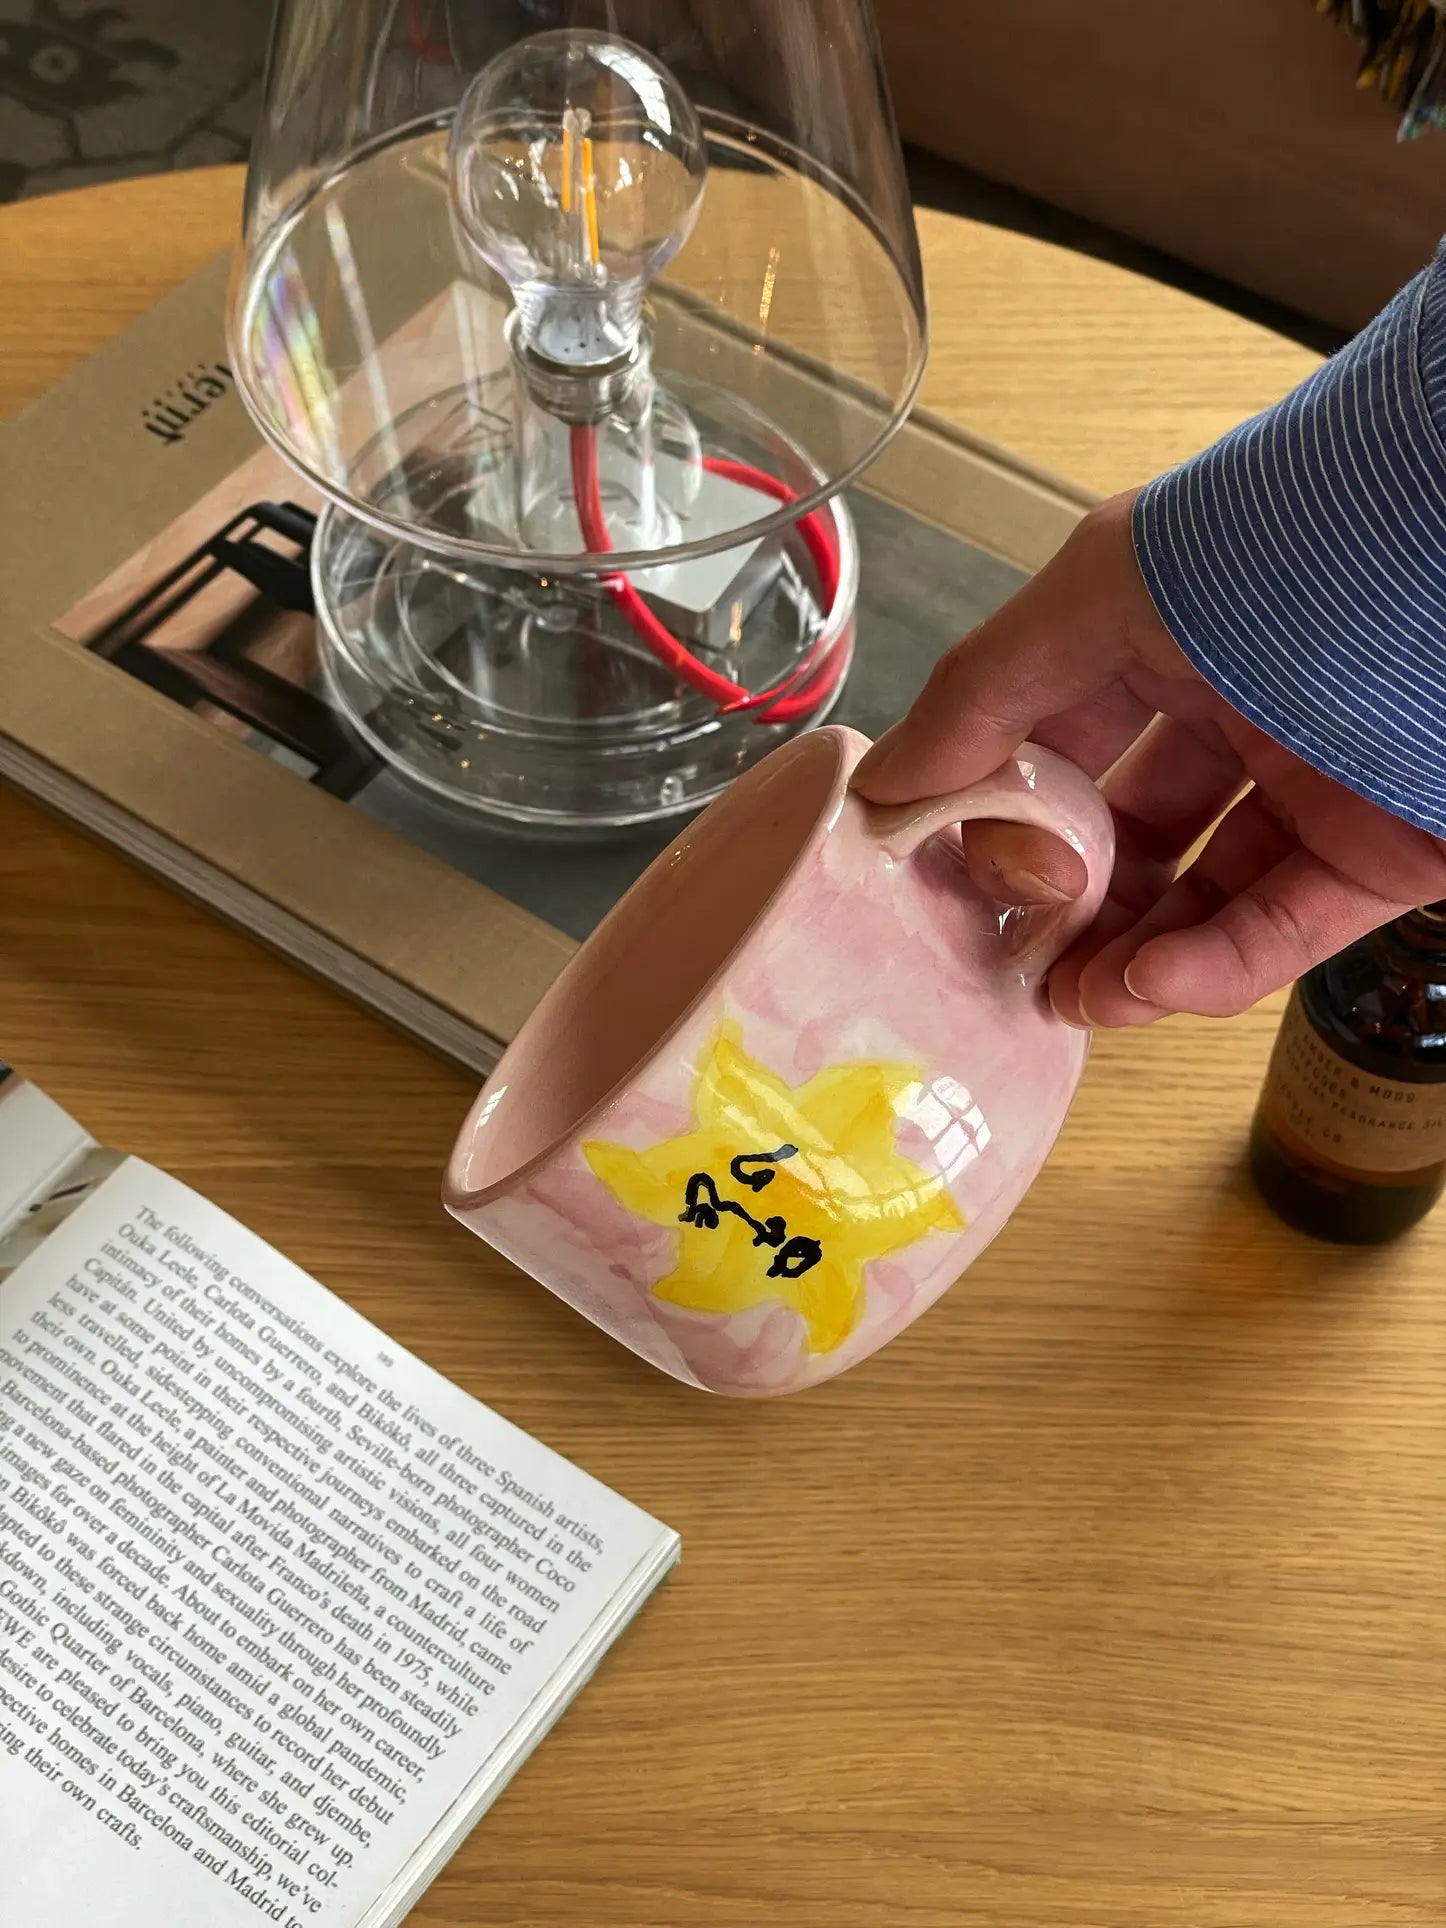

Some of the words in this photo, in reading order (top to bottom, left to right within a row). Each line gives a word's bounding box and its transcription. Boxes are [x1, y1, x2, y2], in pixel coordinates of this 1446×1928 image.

[24, 1341, 112, 1406] prominence
[126, 1413, 152, 1437] the
[149, 1430, 199, 1475] height
[235, 1498, 294, 1550] Movida
[292, 1542, 370, 1611] Madrileña,
[386, 1614, 495, 1696] counterculture
[30, 1311, 66, 1338] their
[63, 1335, 97, 1366] own.
[100, 1359, 141, 1397] Ouka
[139, 1389, 182, 1433] Leele,
[190, 1436, 249, 1480] painter
[245, 1477, 279, 1503] and
[269, 1498, 372, 1573] photographer
[369, 1567, 408, 1602] from
[406, 1593, 469, 1648] Madrid,
[469, 1642, 512, 1675] came
[47, 1291, 77, 1317] less
[77, 1314, 144, 1369] travelled,
[144, 1366, 234, 1441] sidestepping
[235, 1437, 330, 1510] conventional
[327, 1508, 403, 1565] narratives
[424, 1578, 463, 1608] craft
[478, 1612, 507, 1639] life
[65, 1273, 100, 1303] have
[114, 1312, 156, 1344] some
[150, 1341, 196, 1375] point
[211, 1384, 249, 1416] their
[246, 1413, 321, 1473] respective
[315, 1467, 385, 1521] journeys
[385, 1518, 462, 1574] embarked
[481, 1584, 508, 1608] the
[507, 1604, 548, 1634] road
[84, 1258, 138, 1304] Capitán.
[143, 1297, 196, 1342] United
[214, 1356, 334, 1455] uncompromising
[333, 1449, 386, 1491] artistic
[389, 1488, 441, 1535] visions,
[445, 1530, 471, 1550] all
[468, 1543, 504, 1573] four
[505, 1570, 560, 1613] women
[100, 1243, 163, 1289] intimacy
[178, 1297, 217, 1328] their
[213, 1321, 263, 1366] homes
[295, 1386, 342, 1432] fourth,
[345, 1424, 436, 1497] Seville-born
[431, 1492, 535, 1563] photographer
[535, 1558, 576, 1593] Coco
[118, 1223, 157, 1256] Ouka
[157, 1250, 199, 1290] Leele,
[203, 1284, 256, 1330] Carlota
[257, 1325, 322, 1386] Guerrero,
[325, 1382, 359, 1408] and
[414, 1448, 440, 1467] all
[438, 1462, 478, 1495] three
[479, 1492, 548, 1541] captured
[565, 1549, 592, 1573] the
[136, 1205, 164, 1231] The
[162, 1225, 230, 1282] following
[228, 1276, 325, 1353] conversations
[323, 1350, 377, 1394] explore
[376, 1389, 403, 1412] the
[401, 1405, 438, 1438] lives
[456, 1445, 496, 1477] three
[494, 1470, 555, 1518] Spanish
[554, 1514, 603, 1555] artists,
[0, 1379, 120, 1475] Barcelona-based
[110, 1471, 213, 1550] photographer
[211, 1545, 266, 1594] Carlota
[266, 1588, 334, 1644] Guerrero
[332, 1636, 363, 1666] has
[362, 1657, 401, 1694] been
[399, 1690, 462, 1739] steadily
[0, 1442, 52, 1490] images
[49, 1484, 76, 1508] for
[72, 1505, 109, 1535] over
[116, 1540, 170, 1589] decade.
[171, 1584, 222, 1626] About
[236, 1635, 294, 1682] embark
[312, 1688, 343, 1716] her
[340, 1713, 375, 1743] own
[374, 1739, 426, 1784] career,
[0, 1580, 50, 1627] Gothic
[50, 1622, 111, 1675] Quarter
[127, 1686, 205, 1758] Barcelona,
[212, 1752, 259, 1793] where
[258, 1790, 288, 1815] she
[284, 1813, 331, 1846] grew
[22, 1432, 58, 1459] new
[50, 1457, 91, 1488] gaze
[108, 1497, 187, 1564] femininity
[183, 1560, 217, 1587] and
[211, 1582, 280, 1638] sexuality
[277, 1631, 337, 1681] through
[334, 1671, 365, 1699] her
[357, 1694, 446, 1760] profoundly
[51, 1588, 123, 1655] including
[125, 1649, 174, 1698] vocals,
[173, 1693, 222, 1736] piano,
[224, 1732, 277, 1776] guitar,
[280, 1771, 315, 1799] and
[313, 1794, 371, 1849] djembe,
[54, 1557, 95, 1594] these
[92, 1590, 150, 1638] strange
[148, 1635, 255, 1720] circumstances
[270, 1729, 326, 1772] record
[320, 1762, 350, 1791] her
[348, 1786, 394, 1825] debut
[65, 1398, 98, 1427] that
[95, 1421, 144, 1461] flared
[156, 1470, 183, 1495] the
[181, 1492, 236, 1534] capital
[230, 1531, 270, 1562] after
[330, 1605, 373, 1641] death
[393, 1648, 433, 1687] 1975,
[436, 1680, 479, 1717] while
[66, 1532, 97, 1561] was
[96, 1556, 149, 1601] forced
[145, 1593, 183, 1631] back
[182, 1623, 227, 1664] home
[226, 1662, 272, 1696] amid
[277, 1703, 334, 1743] global
[326, 1739, 406, 1805] pandemic,
[24, 1747, 63, 1781] their
[61, 1780, 97, 1811] own
[96, 1808, 142, 1850] crafts.
[31, 1646, 59, 1670] are
[54, 1668, 121, 1718] pleased
[135, 1725, 178, 1770] bring
[173, 1763, 209, 1791] you
[209, 1786, 241, 1815] this
[241, 1812, 310, 1865] editorial
[307, 1863, 338, 1888] col-
[46, 1727, 99, 1776] homes
[116, 1784, 193, 1851] Barcelona
[193, 1848, 229, 1875] and
[224, 1868, 288, 1922] Madrid
[52, 1699, 118, 1755] celebrate
[168, 1792, 273, 1881] craftsmanship,
